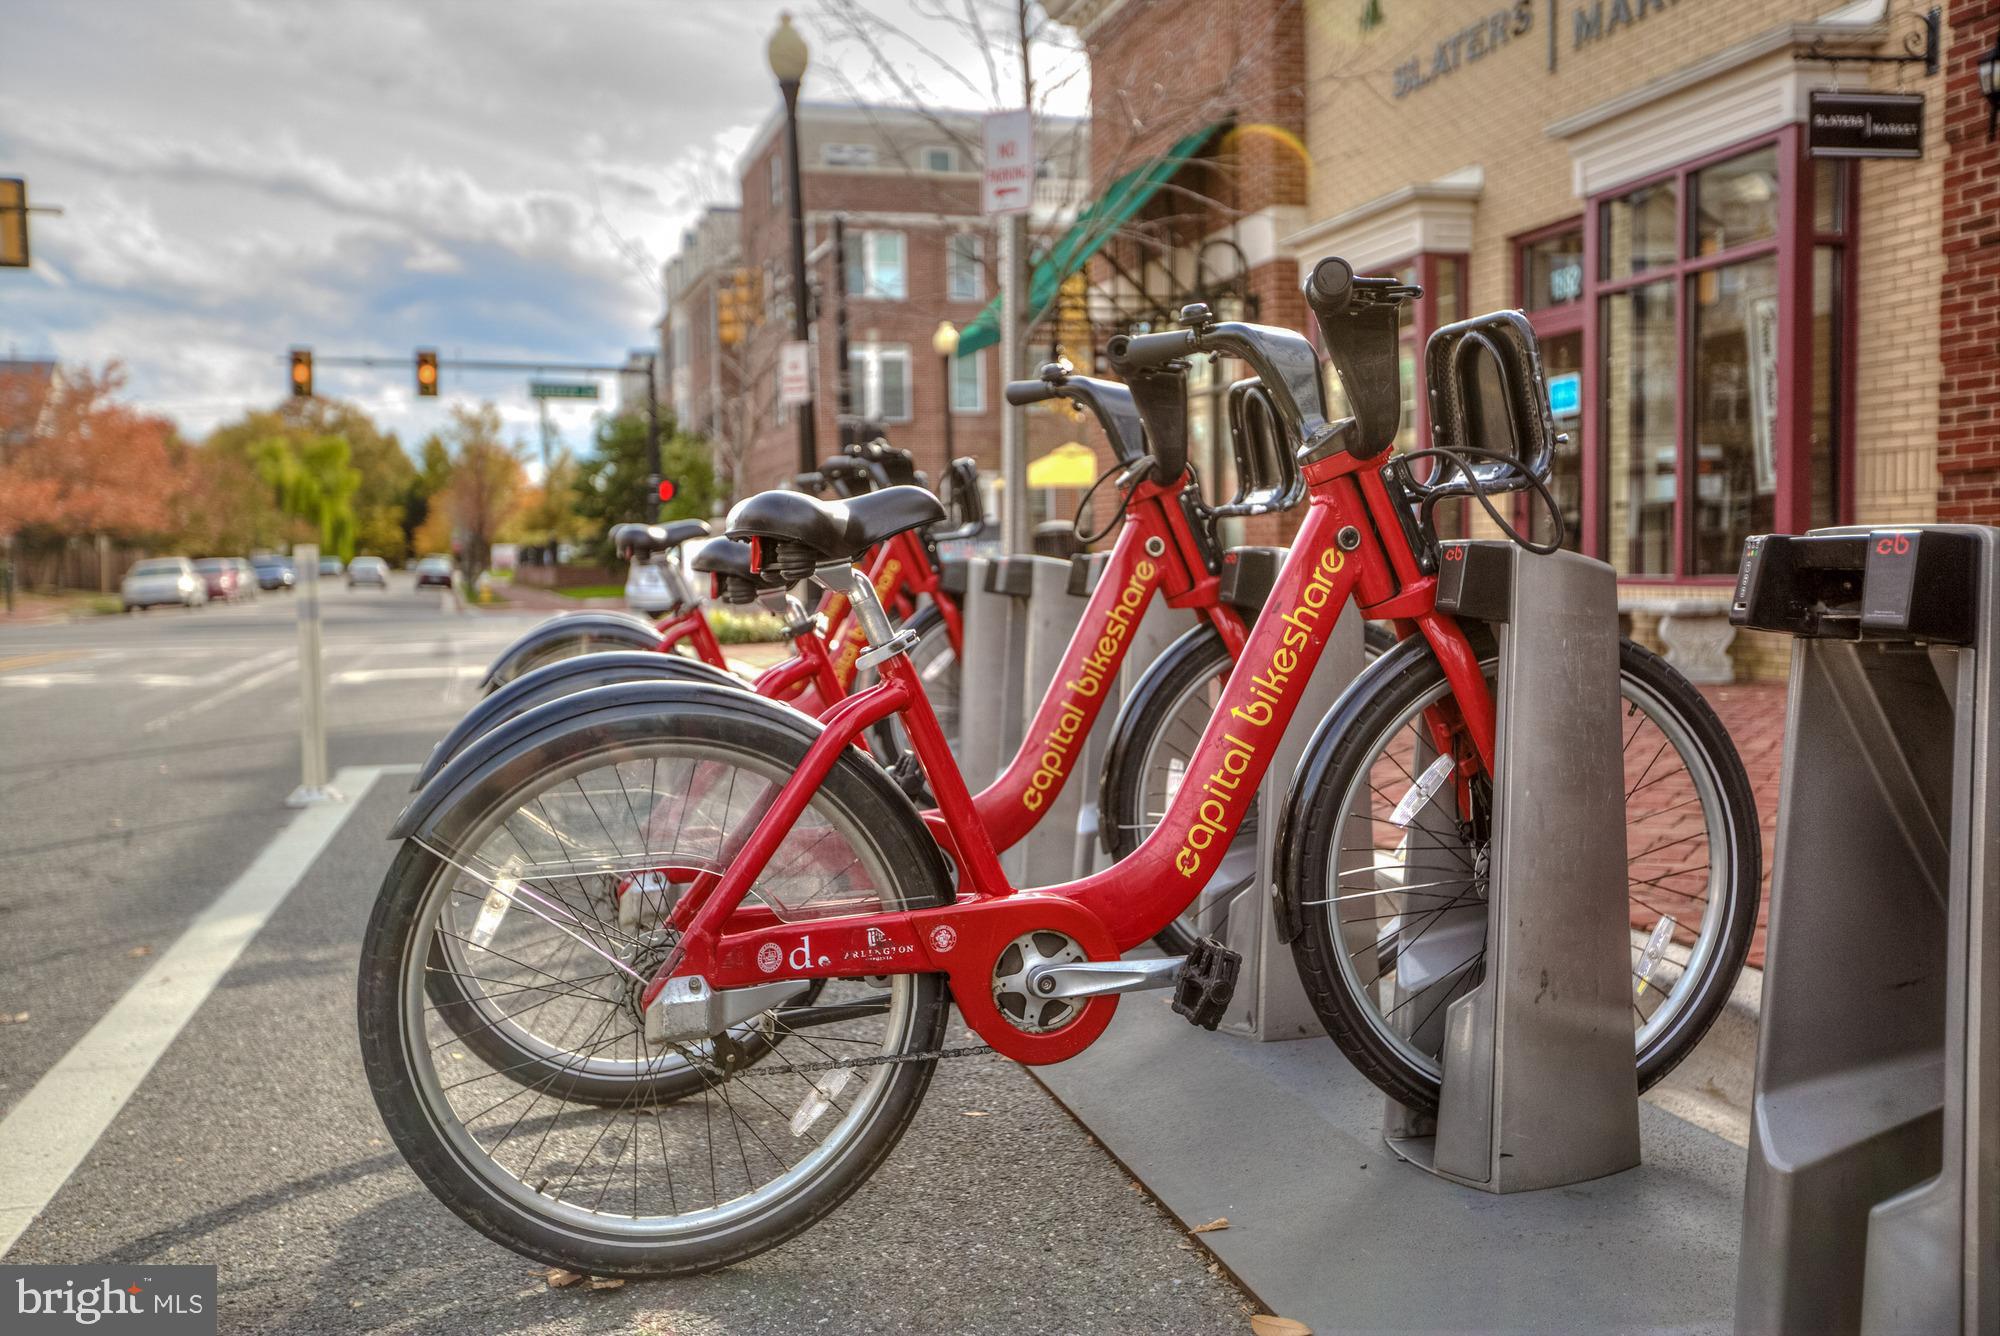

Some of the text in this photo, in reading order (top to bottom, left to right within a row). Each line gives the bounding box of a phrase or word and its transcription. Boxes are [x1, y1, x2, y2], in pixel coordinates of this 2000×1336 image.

[1393, 0, 1534, 98] SLATERS
[1814, 113, 1918, 136] SLATERS MARKET
[1023, 560, 1155, 812] capital bikeshare
[1175, 547, 1345, 878] capital bikeshare
